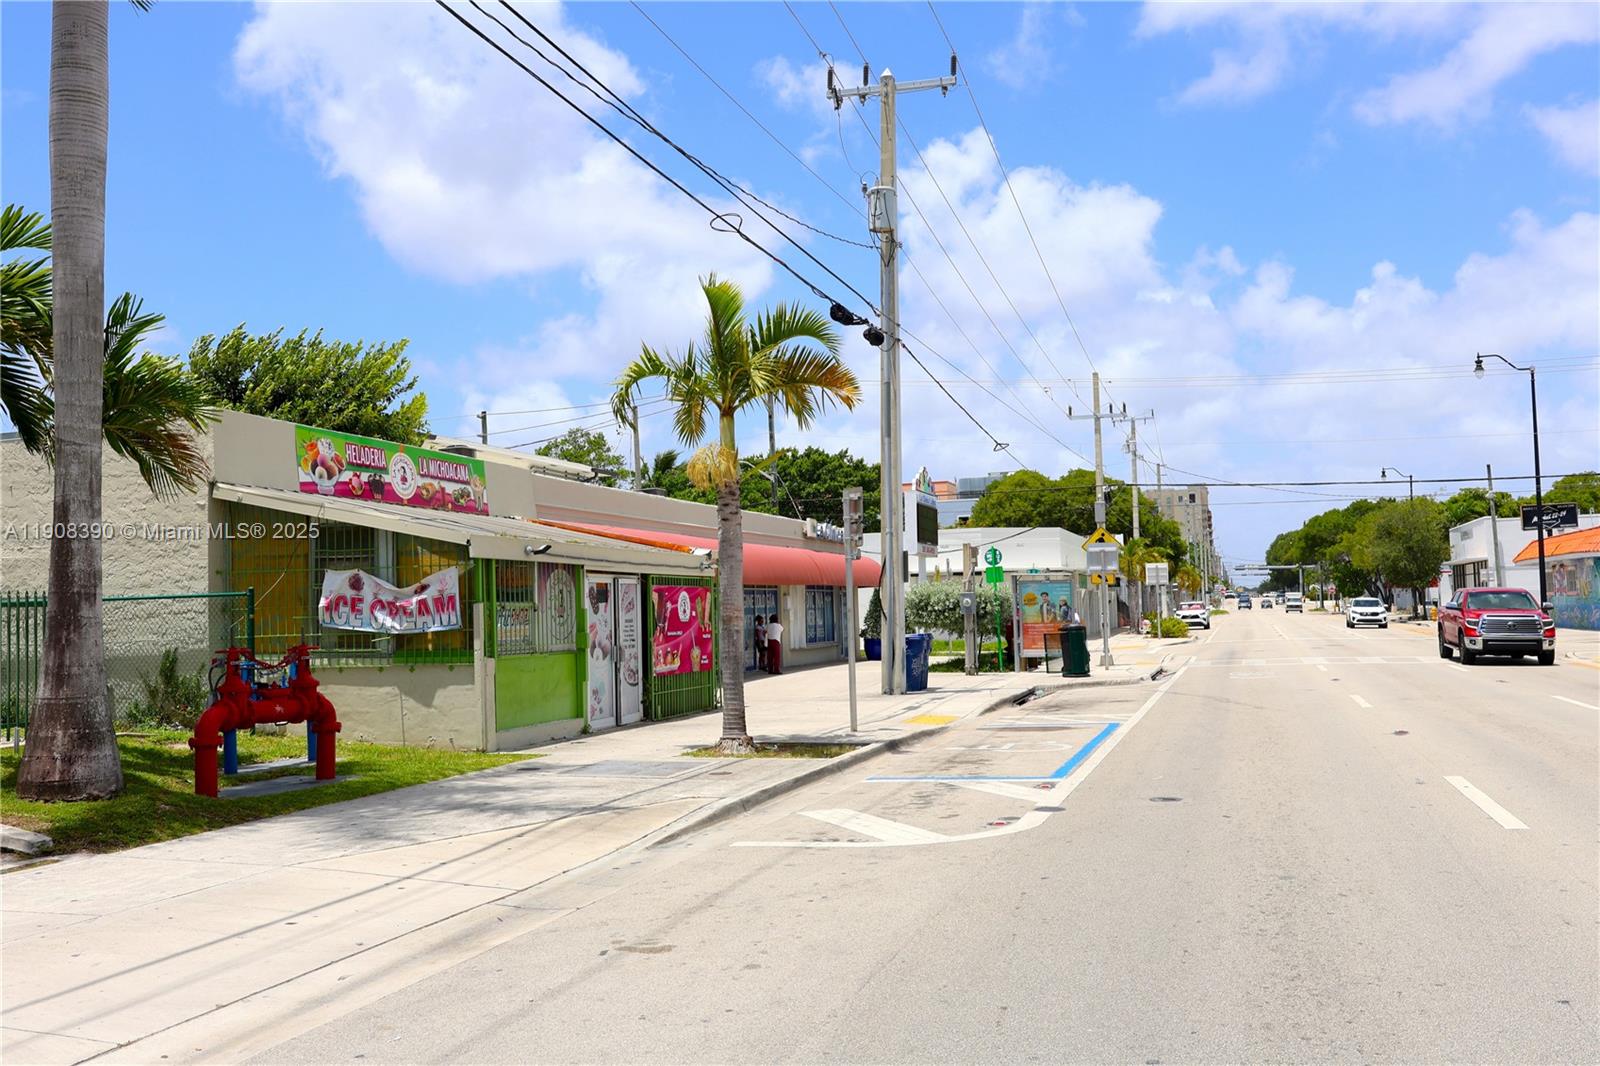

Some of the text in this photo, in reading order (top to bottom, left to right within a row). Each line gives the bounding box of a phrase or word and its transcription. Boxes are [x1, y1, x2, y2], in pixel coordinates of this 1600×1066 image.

[345, 443, 387, 468] HELADERIA
[419, 457, 428, 475] LA
[429, 459, 470, 482] MICHOACANA
[321, 593, 365, 627] ICE
[369, 594, 458, 630] CREAM
